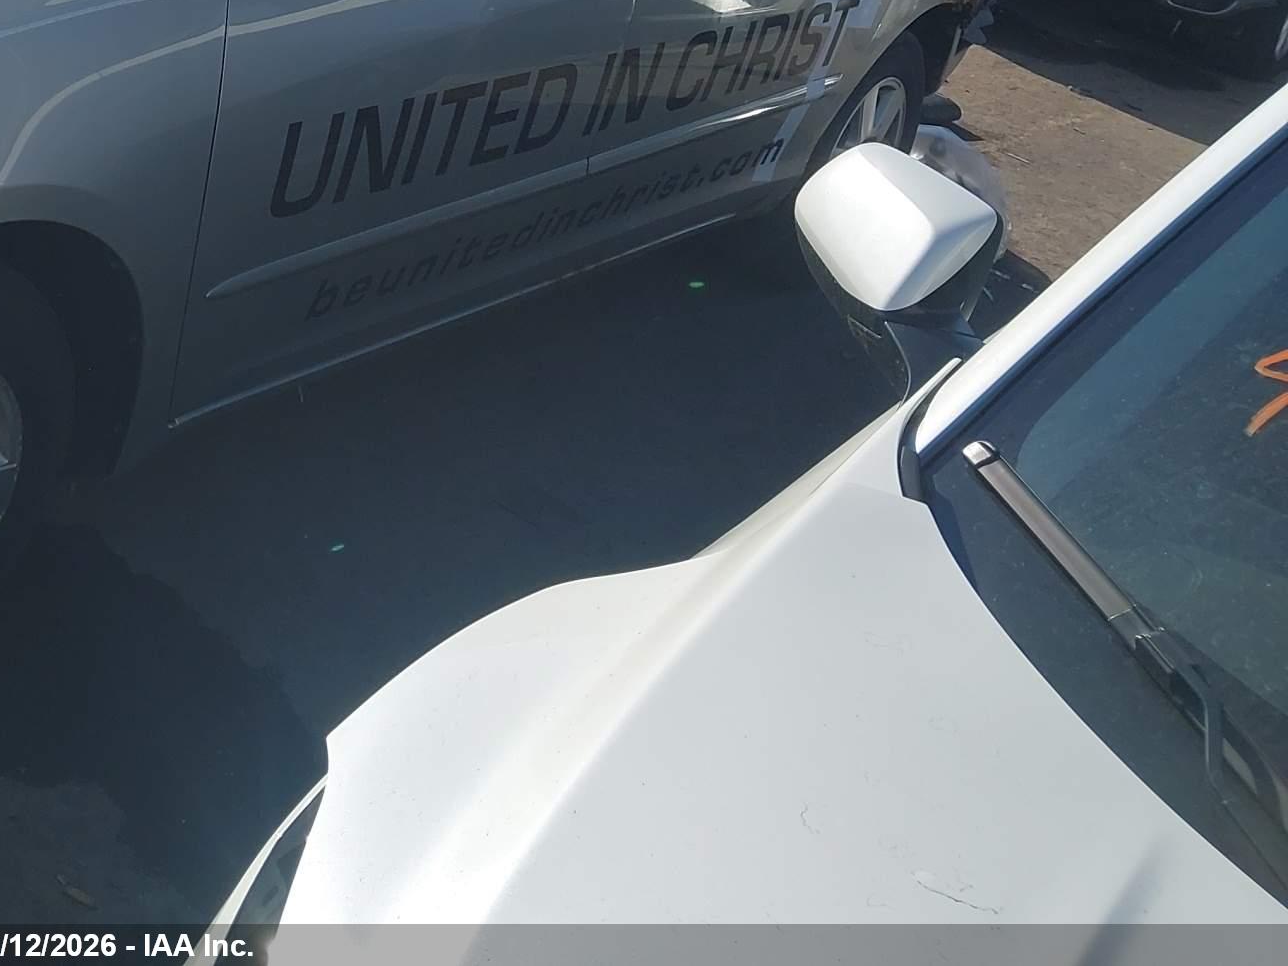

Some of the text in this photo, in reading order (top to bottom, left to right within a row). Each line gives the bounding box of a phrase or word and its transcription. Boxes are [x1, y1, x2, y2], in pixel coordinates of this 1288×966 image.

[269, 62, 578, 218] UNITED
[581, 42, 665, 137] IN
[304, 137, 785, 322] beunitedinchrist.com
